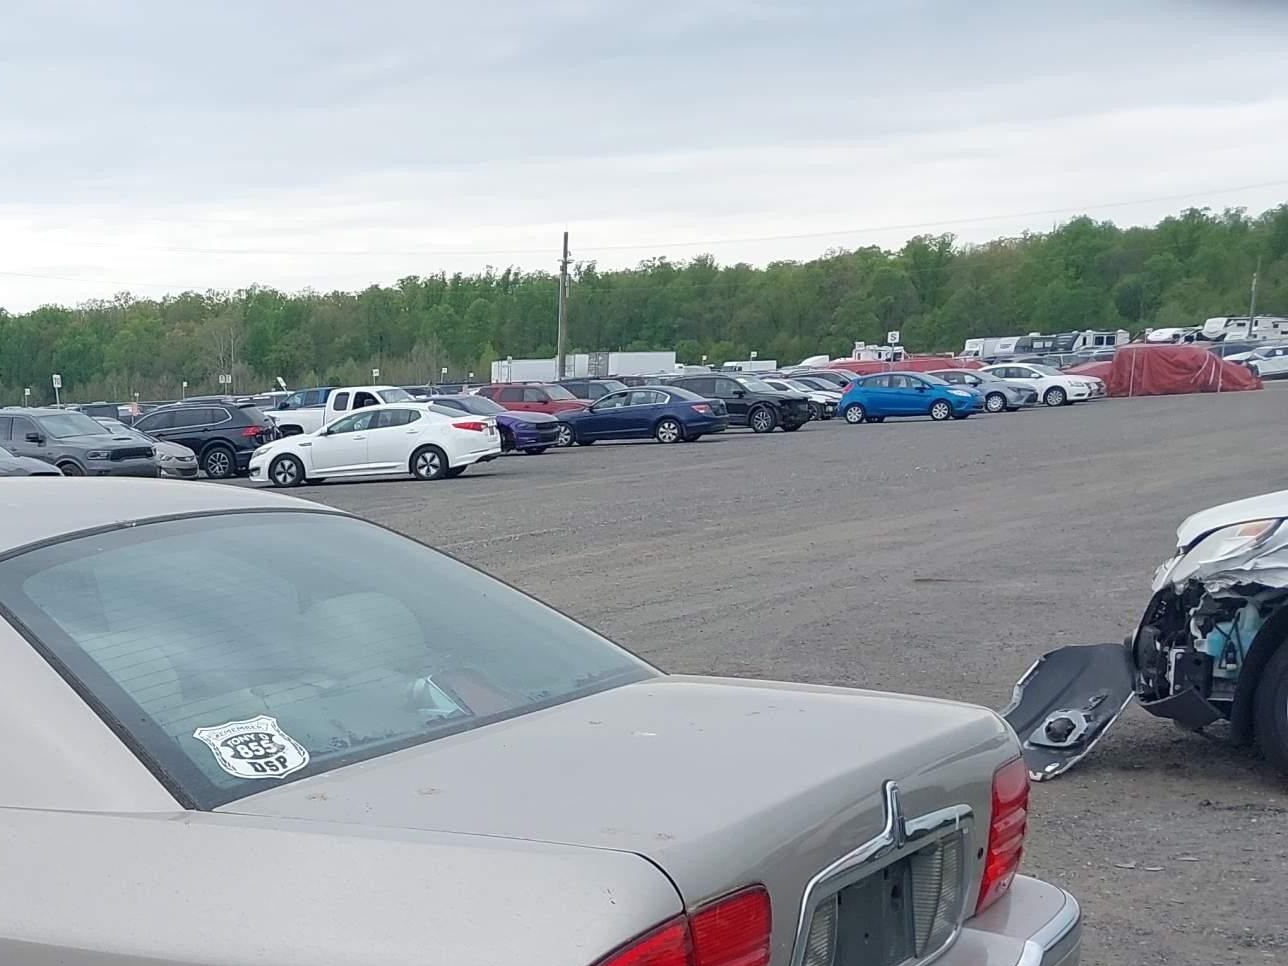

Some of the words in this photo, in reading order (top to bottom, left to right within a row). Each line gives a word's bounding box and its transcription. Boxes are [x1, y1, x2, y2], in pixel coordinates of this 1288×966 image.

[890, 333, 897, 341] S
[227, 734, 255, 747] TONY
[236, 740, 278, 758] 855
[247, 755, 288, 773] DSP
